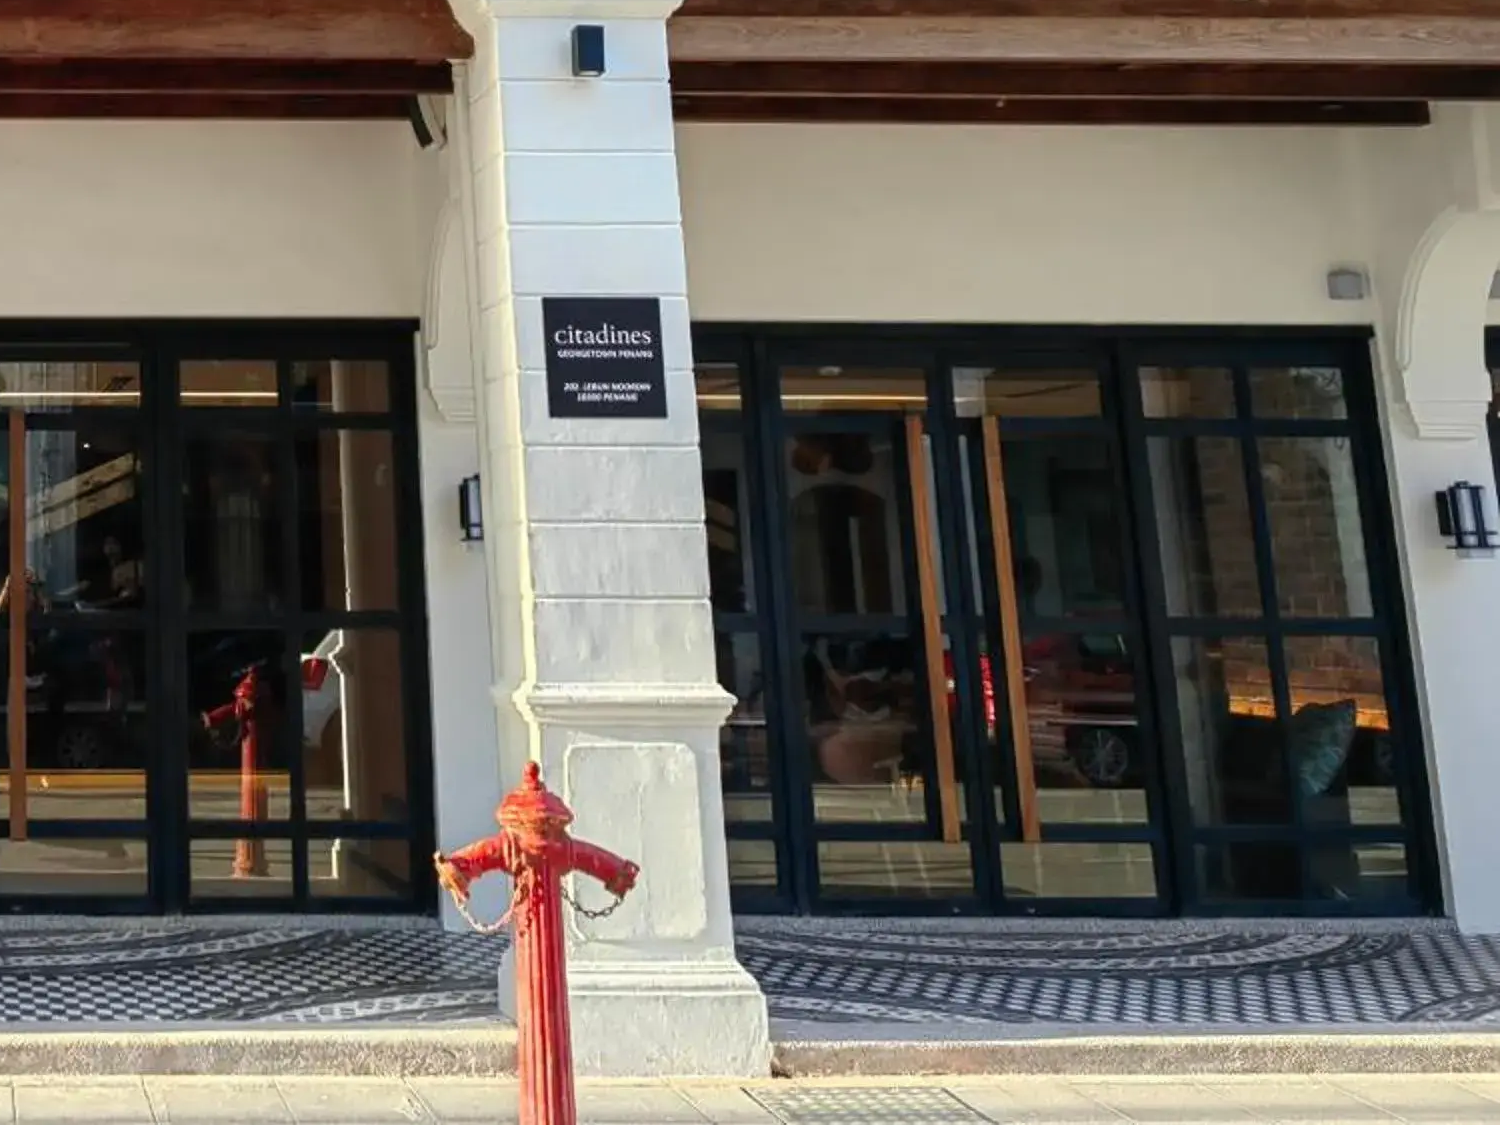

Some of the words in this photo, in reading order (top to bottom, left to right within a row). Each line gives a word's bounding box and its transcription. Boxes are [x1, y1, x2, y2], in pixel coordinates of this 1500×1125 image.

[554, 323, 652, 345] citadines
[557, 349, 617, 359] GEORGETOWN
[618, 349, 654, 359] PENANG
